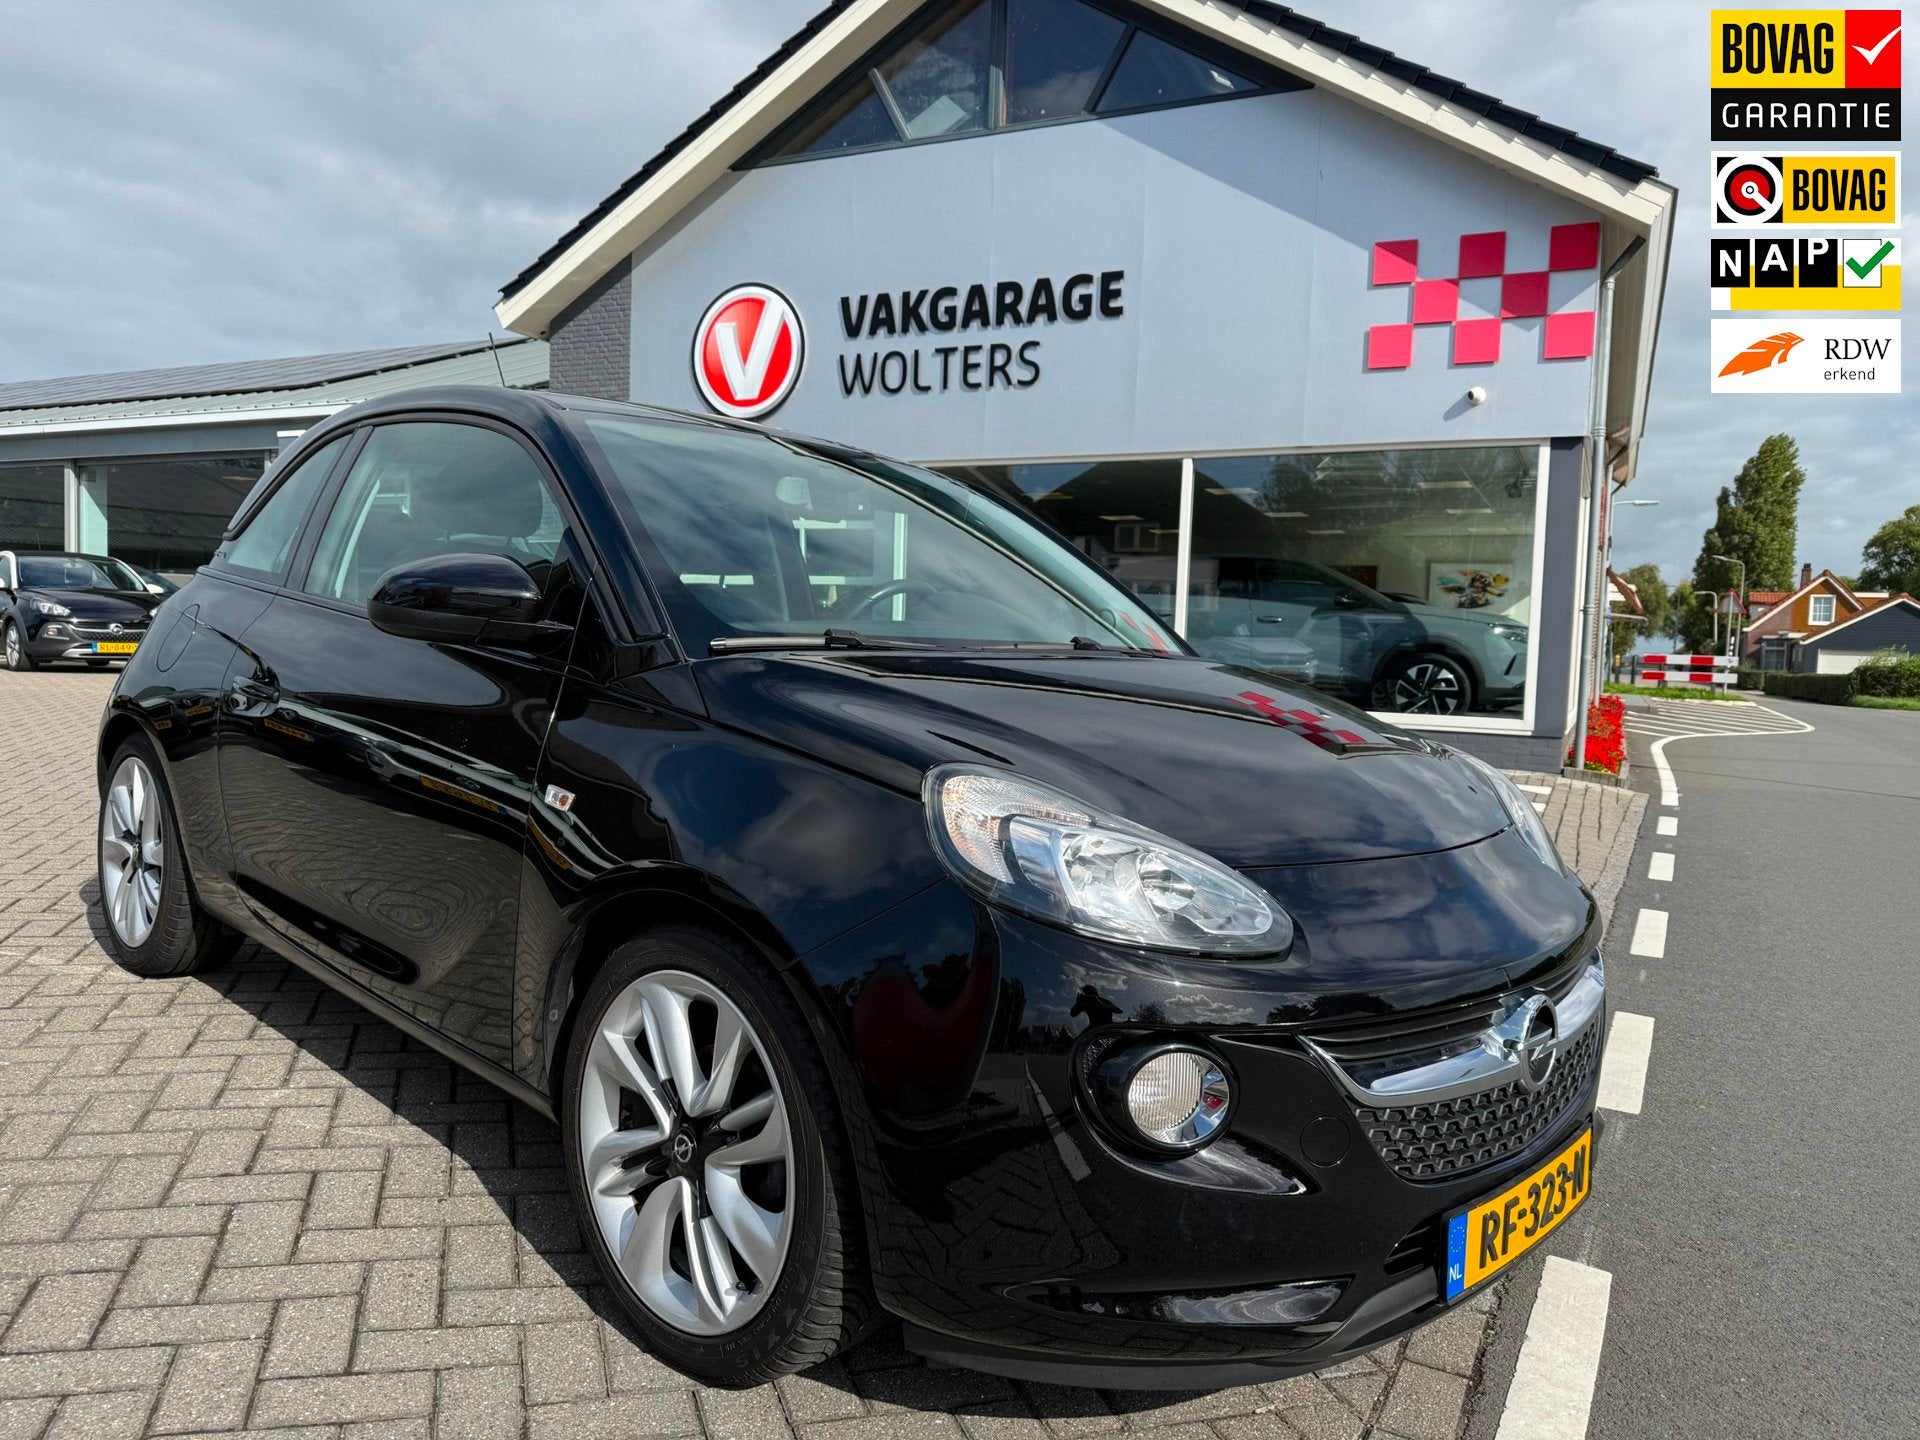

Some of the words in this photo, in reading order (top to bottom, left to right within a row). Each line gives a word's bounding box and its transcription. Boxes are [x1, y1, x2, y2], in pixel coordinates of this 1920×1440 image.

[840, 270, 1125, 338] VAKGARAGE
[716, 297, 788, 401] V
[839, 340, 1042, 396] WOLTERS
[100, 643, 137, 652] RL-849-
[1479, 1144, 1586, 1269] RF-323-N
[1449, 1263, 1463, 1283] NL
